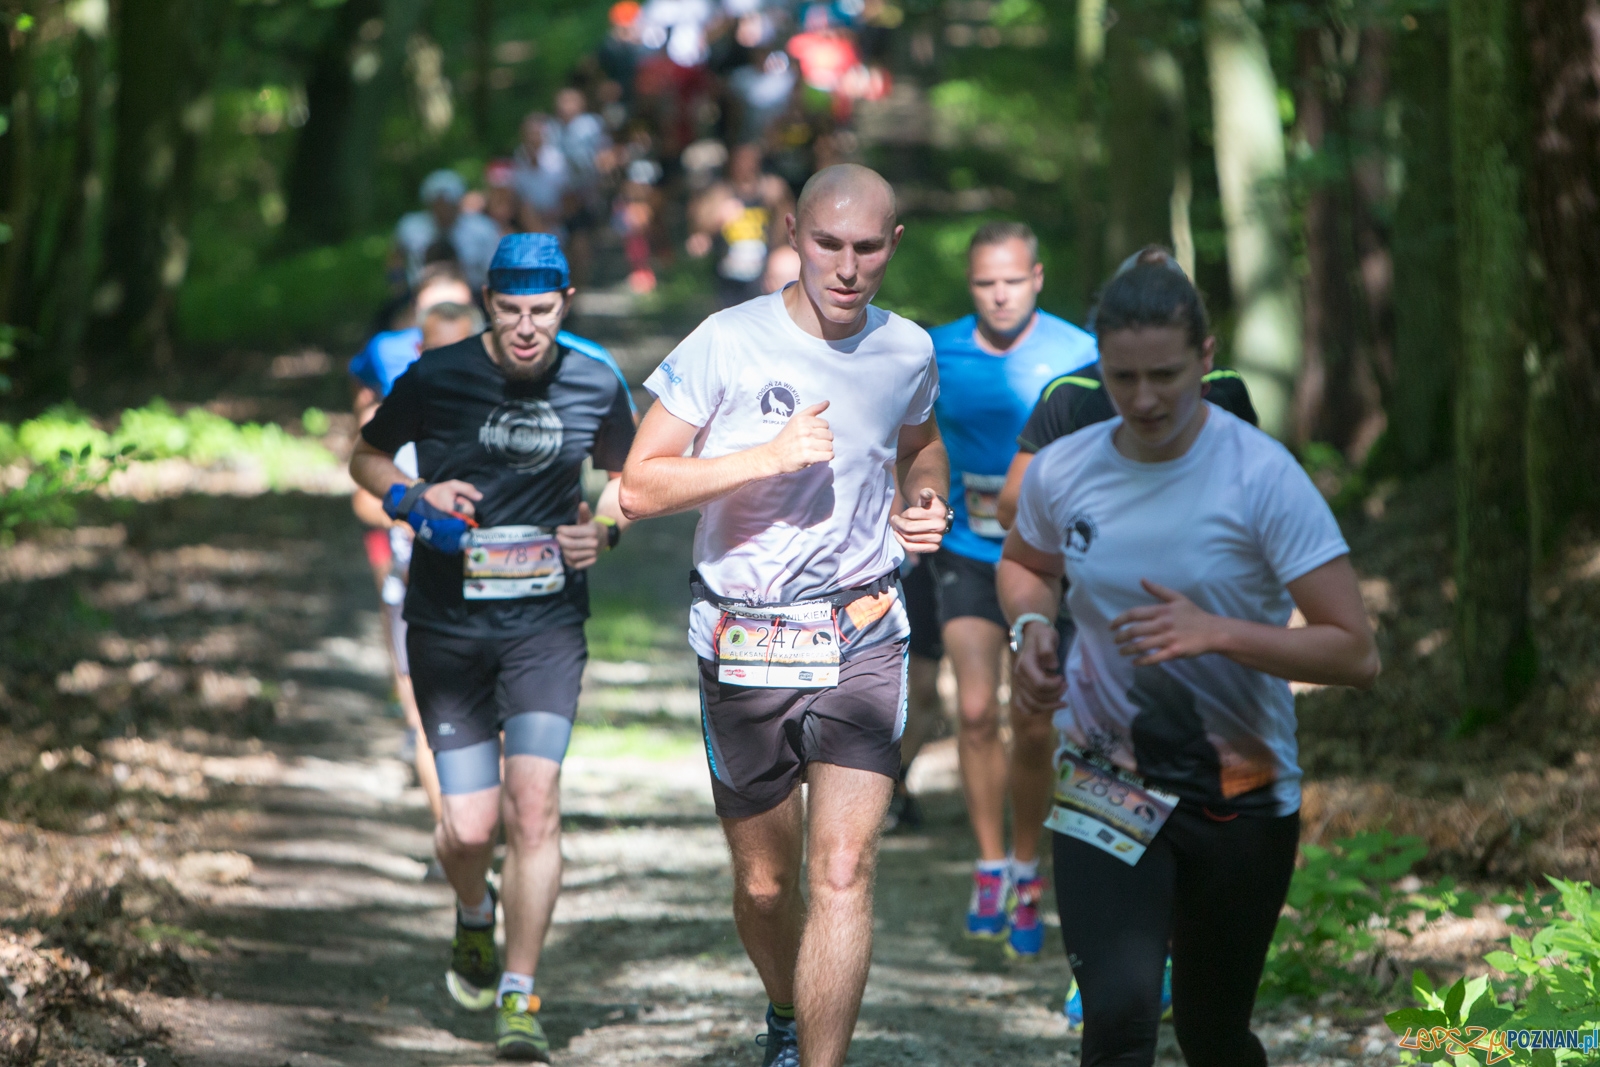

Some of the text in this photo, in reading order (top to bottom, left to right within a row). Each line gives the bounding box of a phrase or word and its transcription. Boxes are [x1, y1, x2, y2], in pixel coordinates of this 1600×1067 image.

[755, 380, 774, 401] POGOŃ
[783, 381, 801, 406] WILKIEM
[503, 545, 528, 567] 78
[756, 626, 802, 649] 247
[1073, 773, 1131, 807] 283
